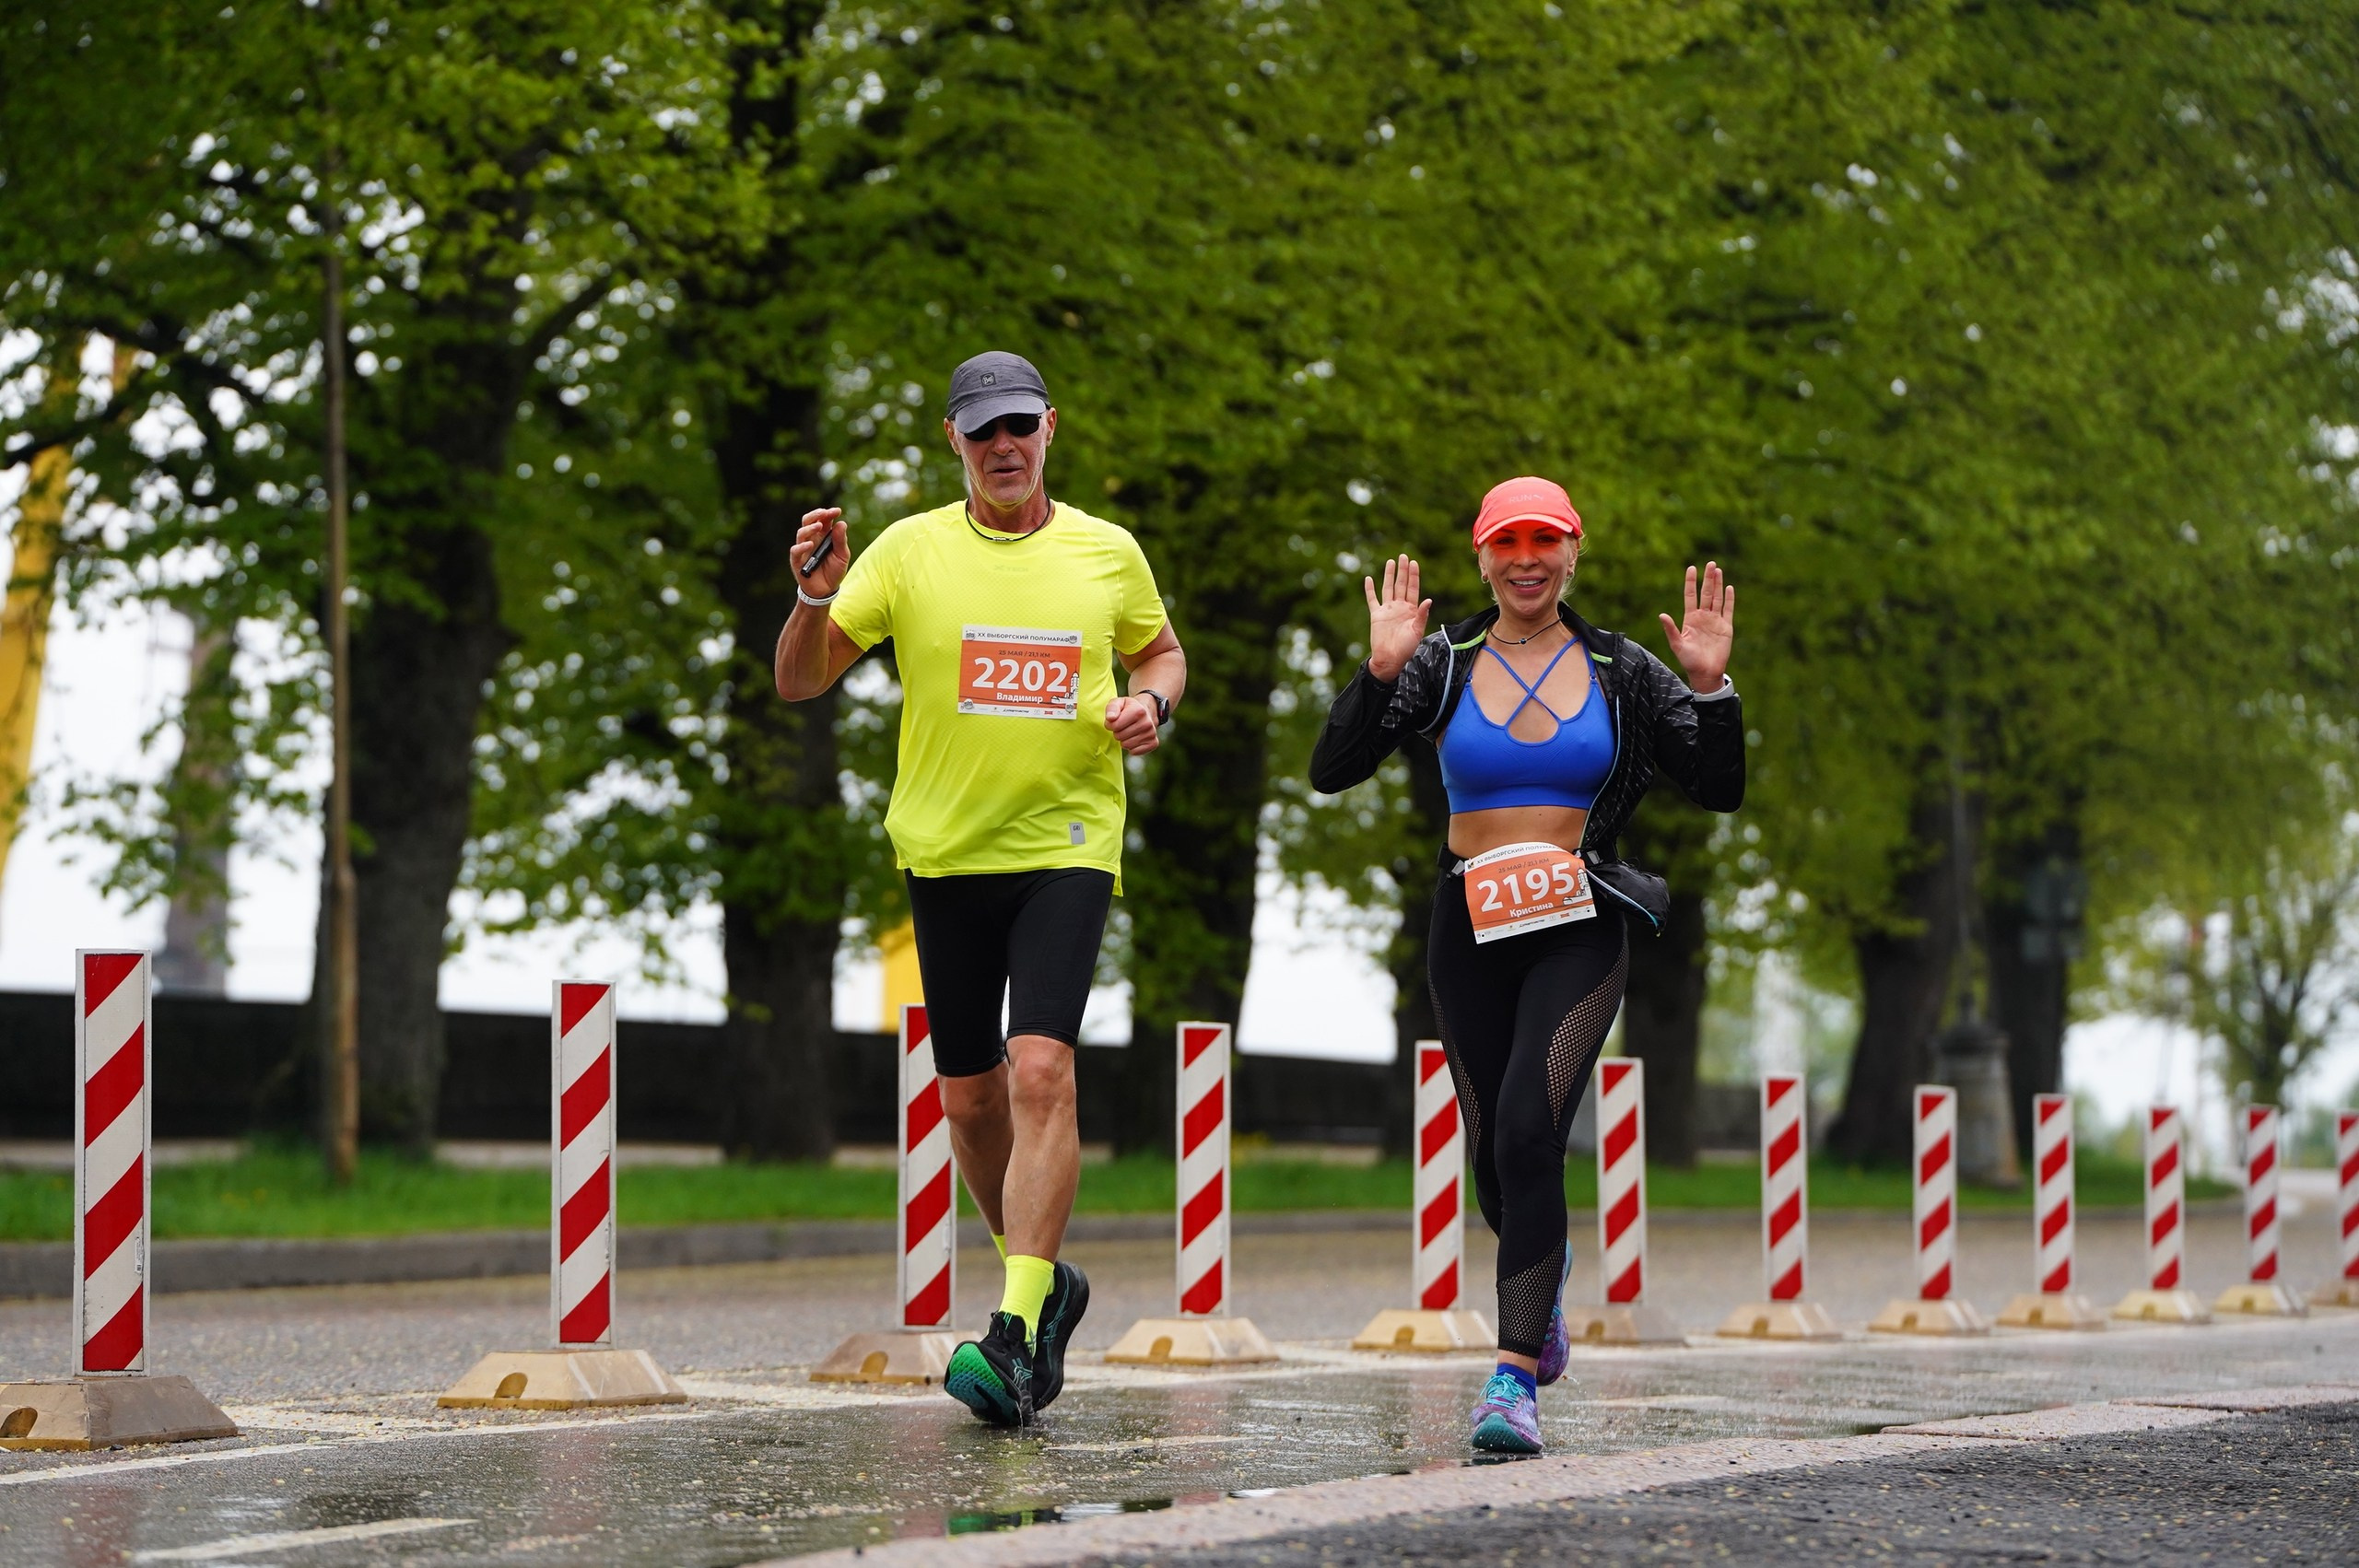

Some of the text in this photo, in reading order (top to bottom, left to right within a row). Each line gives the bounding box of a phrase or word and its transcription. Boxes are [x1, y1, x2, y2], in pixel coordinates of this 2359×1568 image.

[986, 632, 1029, 640] ВЫБОРГСКИЙ
[1029, 635, 1070, 643] ПОЛУМАРАФ
[972, 657, 1068, 692] 2202
[996, 692, 1043, 704] Владимир
[1484, 847, 1525, 861] ВЫБОРГСКИЙ
[1507, 863, 1522, 872] МАЯ
[1477, 862, 1575, 912] 2195
[1509, 902, 1554, 919] Кристина
